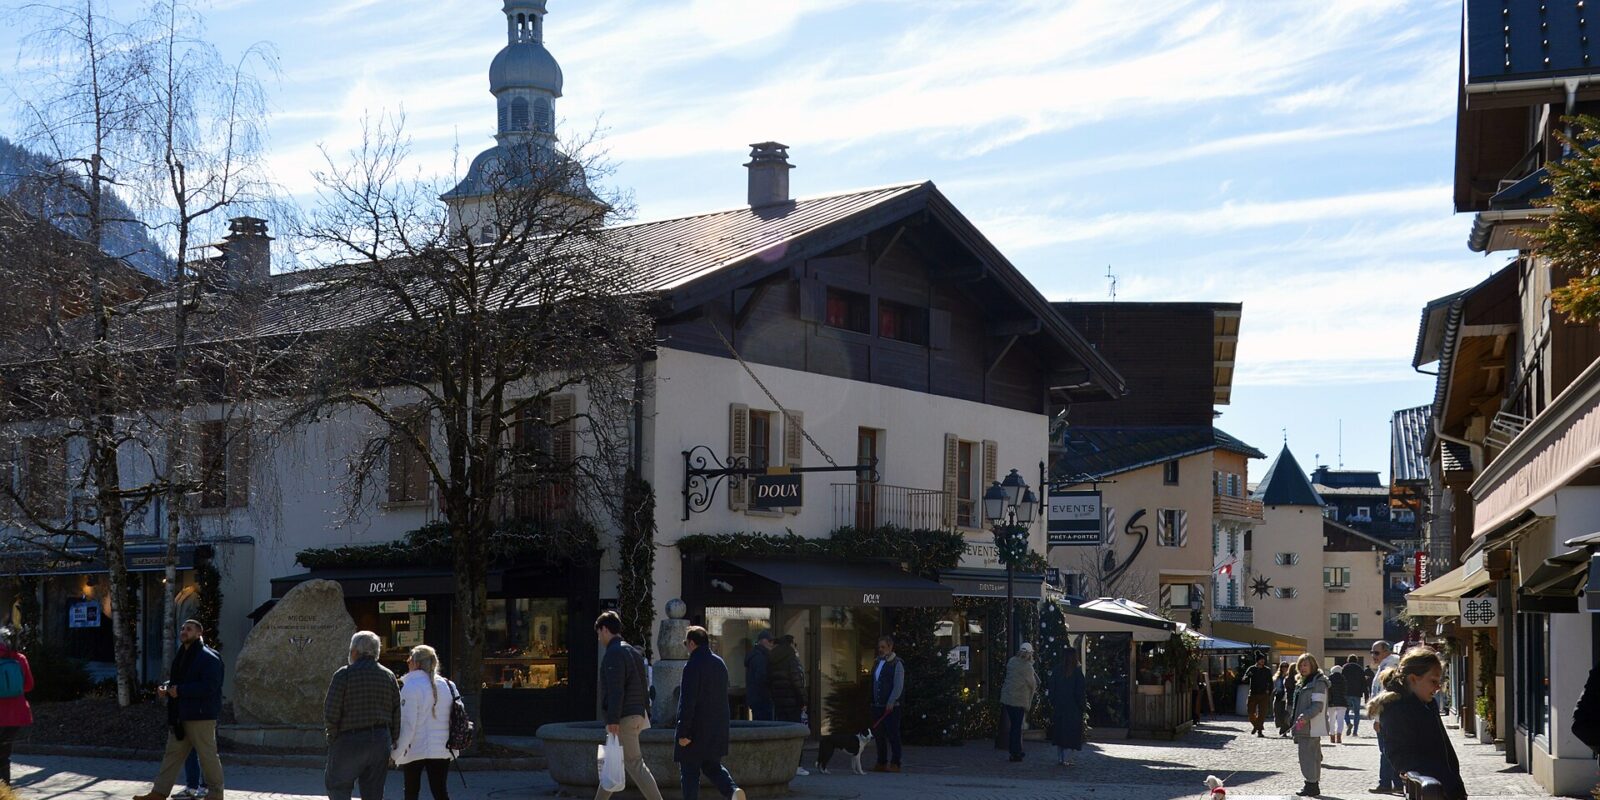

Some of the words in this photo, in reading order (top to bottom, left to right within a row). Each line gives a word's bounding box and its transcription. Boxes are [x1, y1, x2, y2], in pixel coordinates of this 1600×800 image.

[758, 484, 799, 498] DOUX
[1052, 504, 1095, 513] EVENTS
[967, 545, 999, 557] EVENTS
[369, 582, 395, 593] DOUX
[863, 593, 881, 604] DOUX
